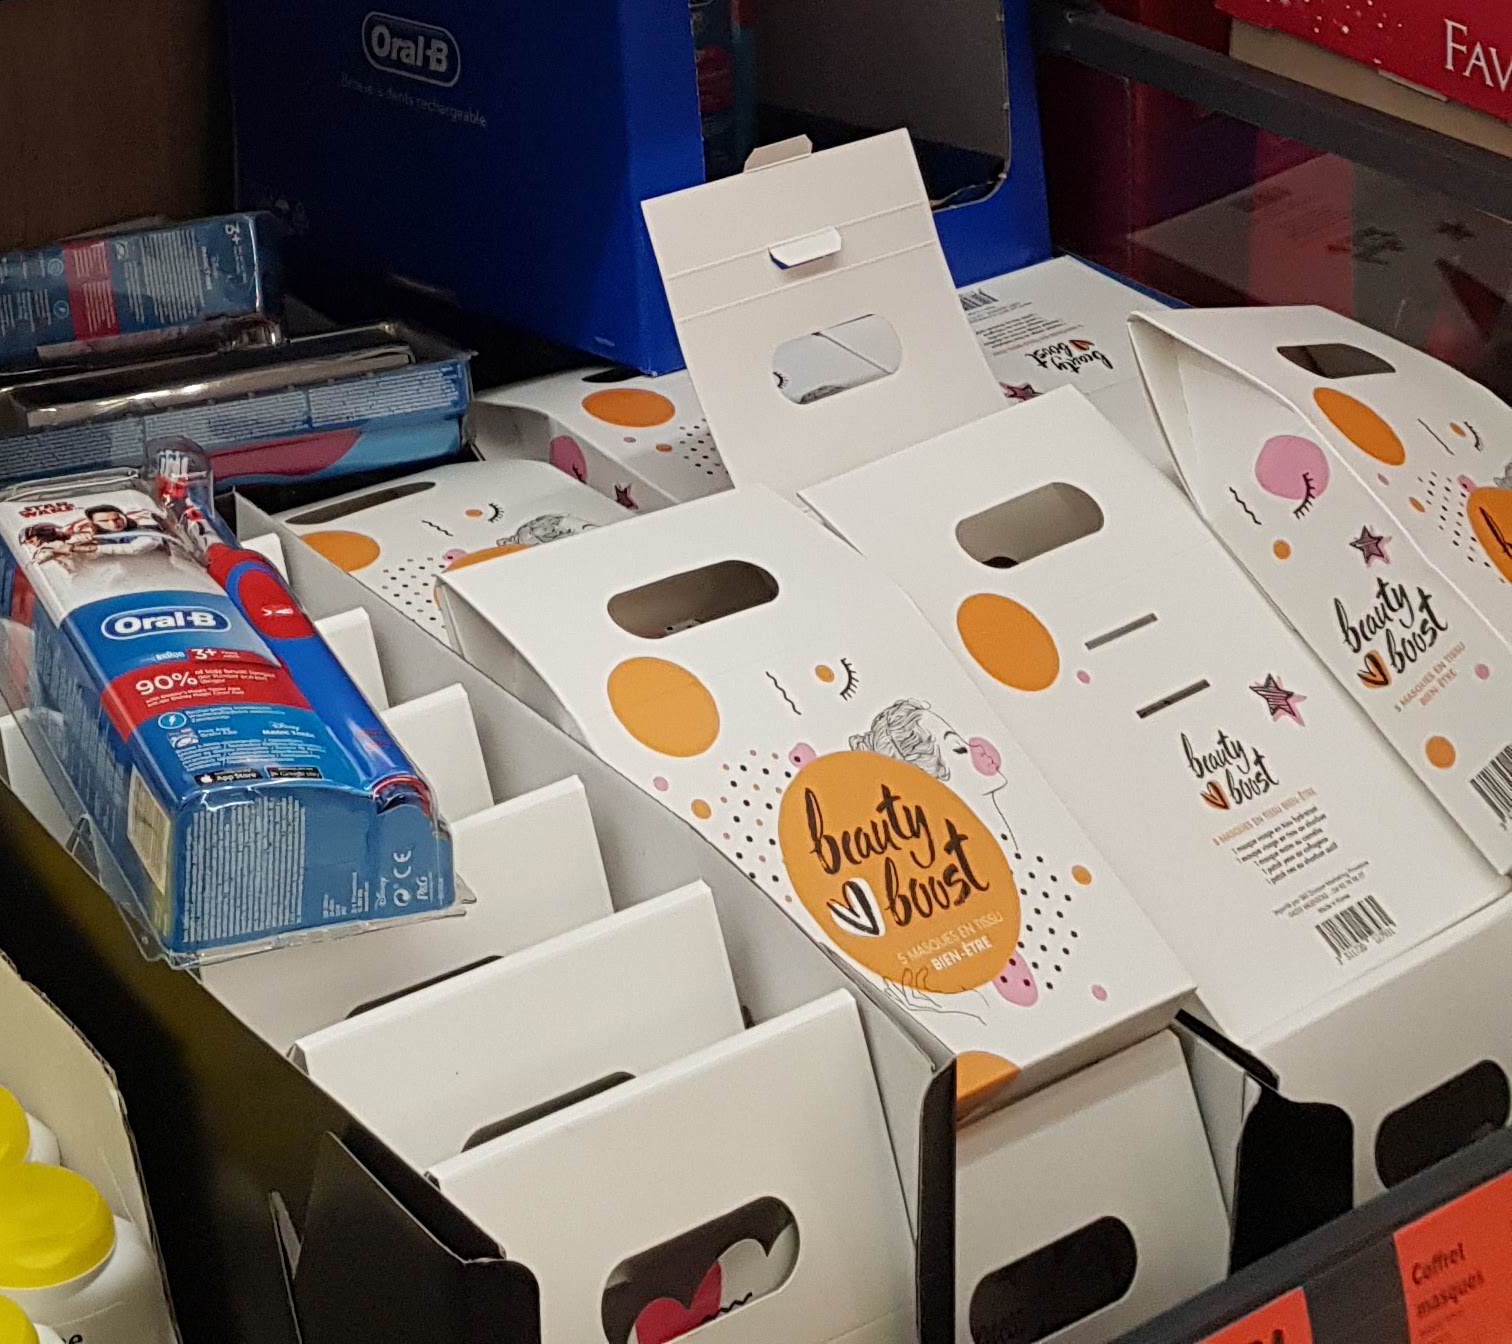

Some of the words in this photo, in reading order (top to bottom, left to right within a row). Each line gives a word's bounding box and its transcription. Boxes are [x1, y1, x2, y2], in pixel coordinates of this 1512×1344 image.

[371, 24, 449, 73] Oral-B
[1025, 342, 1073, 369] boost
[1051, 349, 1114, 374] beauty
[113, 611, 217, 633] Oral-B
[1334, 577, 1415, 654] beauty
[1386, 586, 1448, 674] boost
[191, 648, 217, 661] 3+
[135, 670, 199, 696] 90%
[1401, 670, 1434, 709] MASQUES
[1181, 729, 1251, 779] beauty
[1225, 746, 1280, 805] boost
[805, 783, 936, 875] beauty
[884, 818, 990, 927] boost
[896, 952, 908, 965] 5
[908, 930, 960, 961] MASQUES
[958, 923, 974, 938] EN
[974, 911, 1004, 930] TISSU
[931, 935, 993, 971] BIEN-ÊTRE
